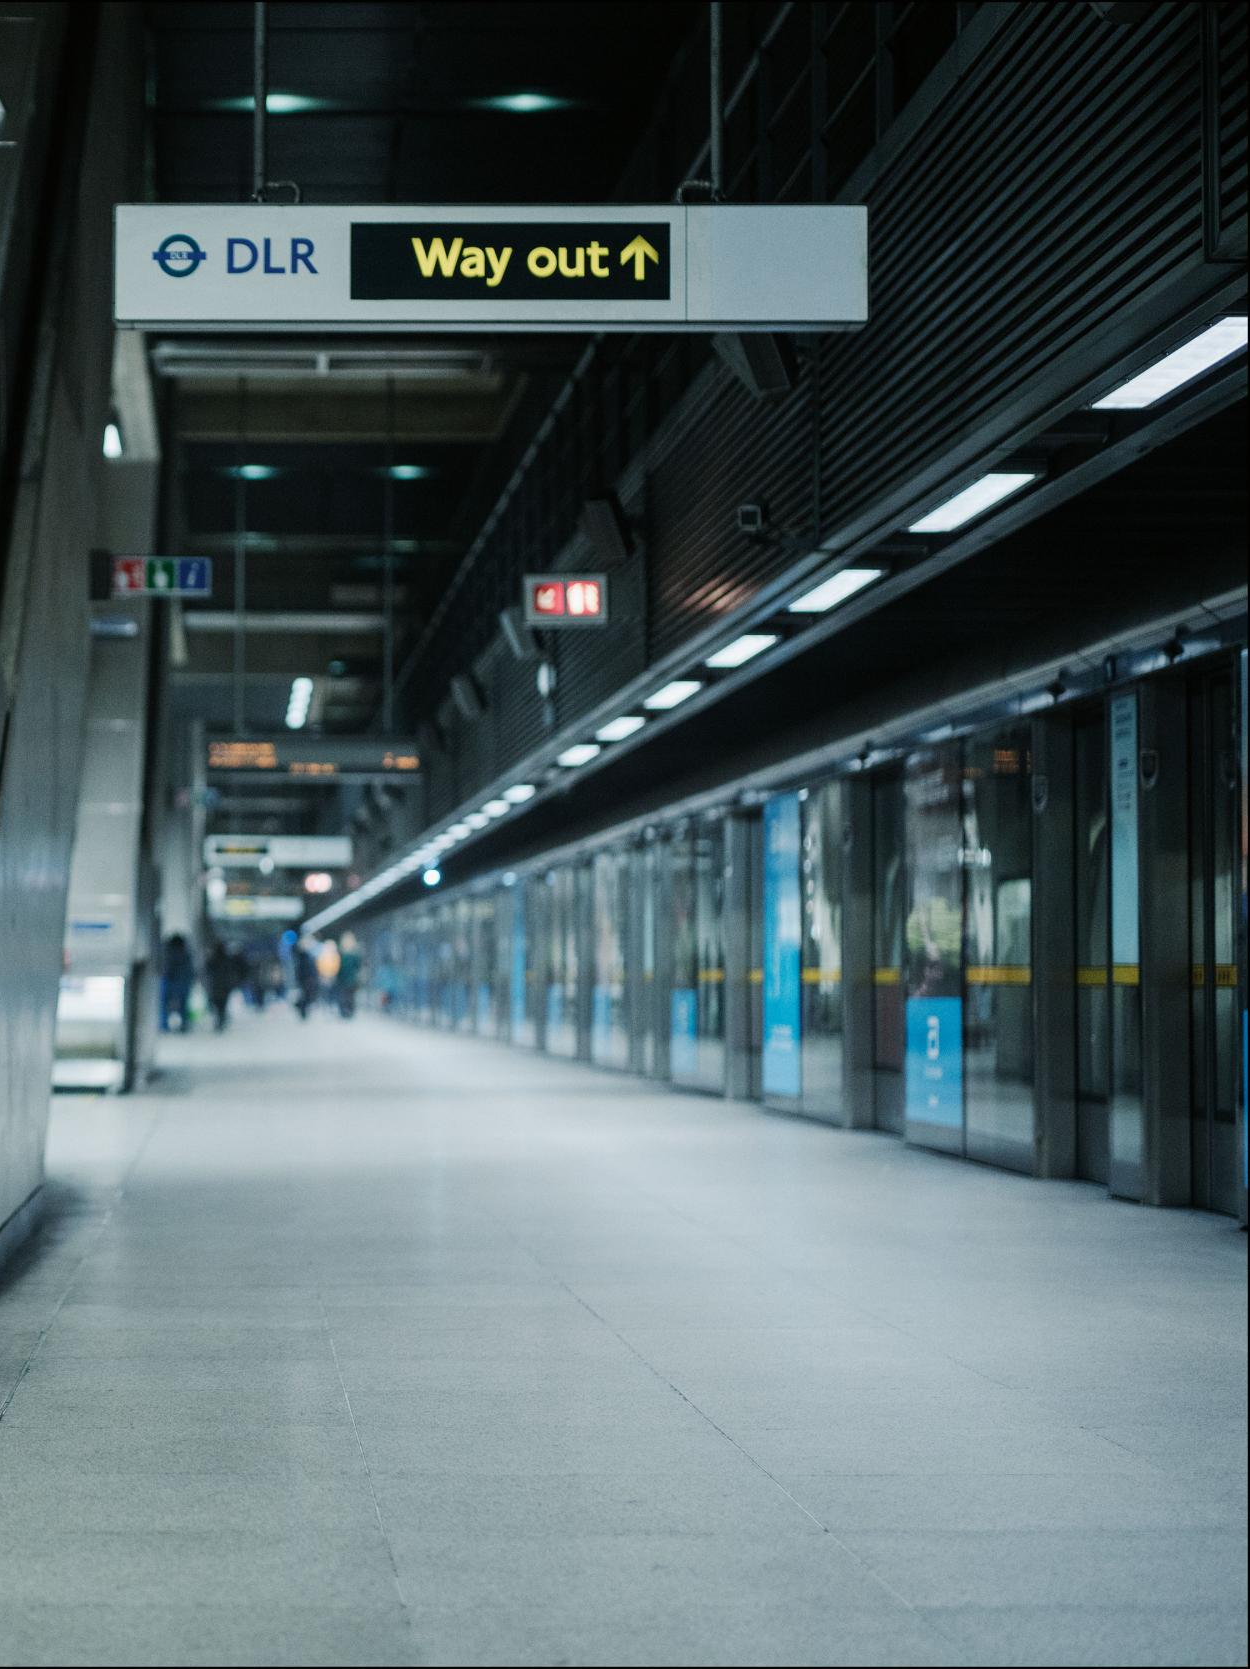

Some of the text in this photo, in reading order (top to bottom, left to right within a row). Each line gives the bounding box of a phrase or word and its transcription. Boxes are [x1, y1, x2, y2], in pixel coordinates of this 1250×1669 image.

[227, 237, 318, 274] DLR
[411, 237, 610, 288] Way out
